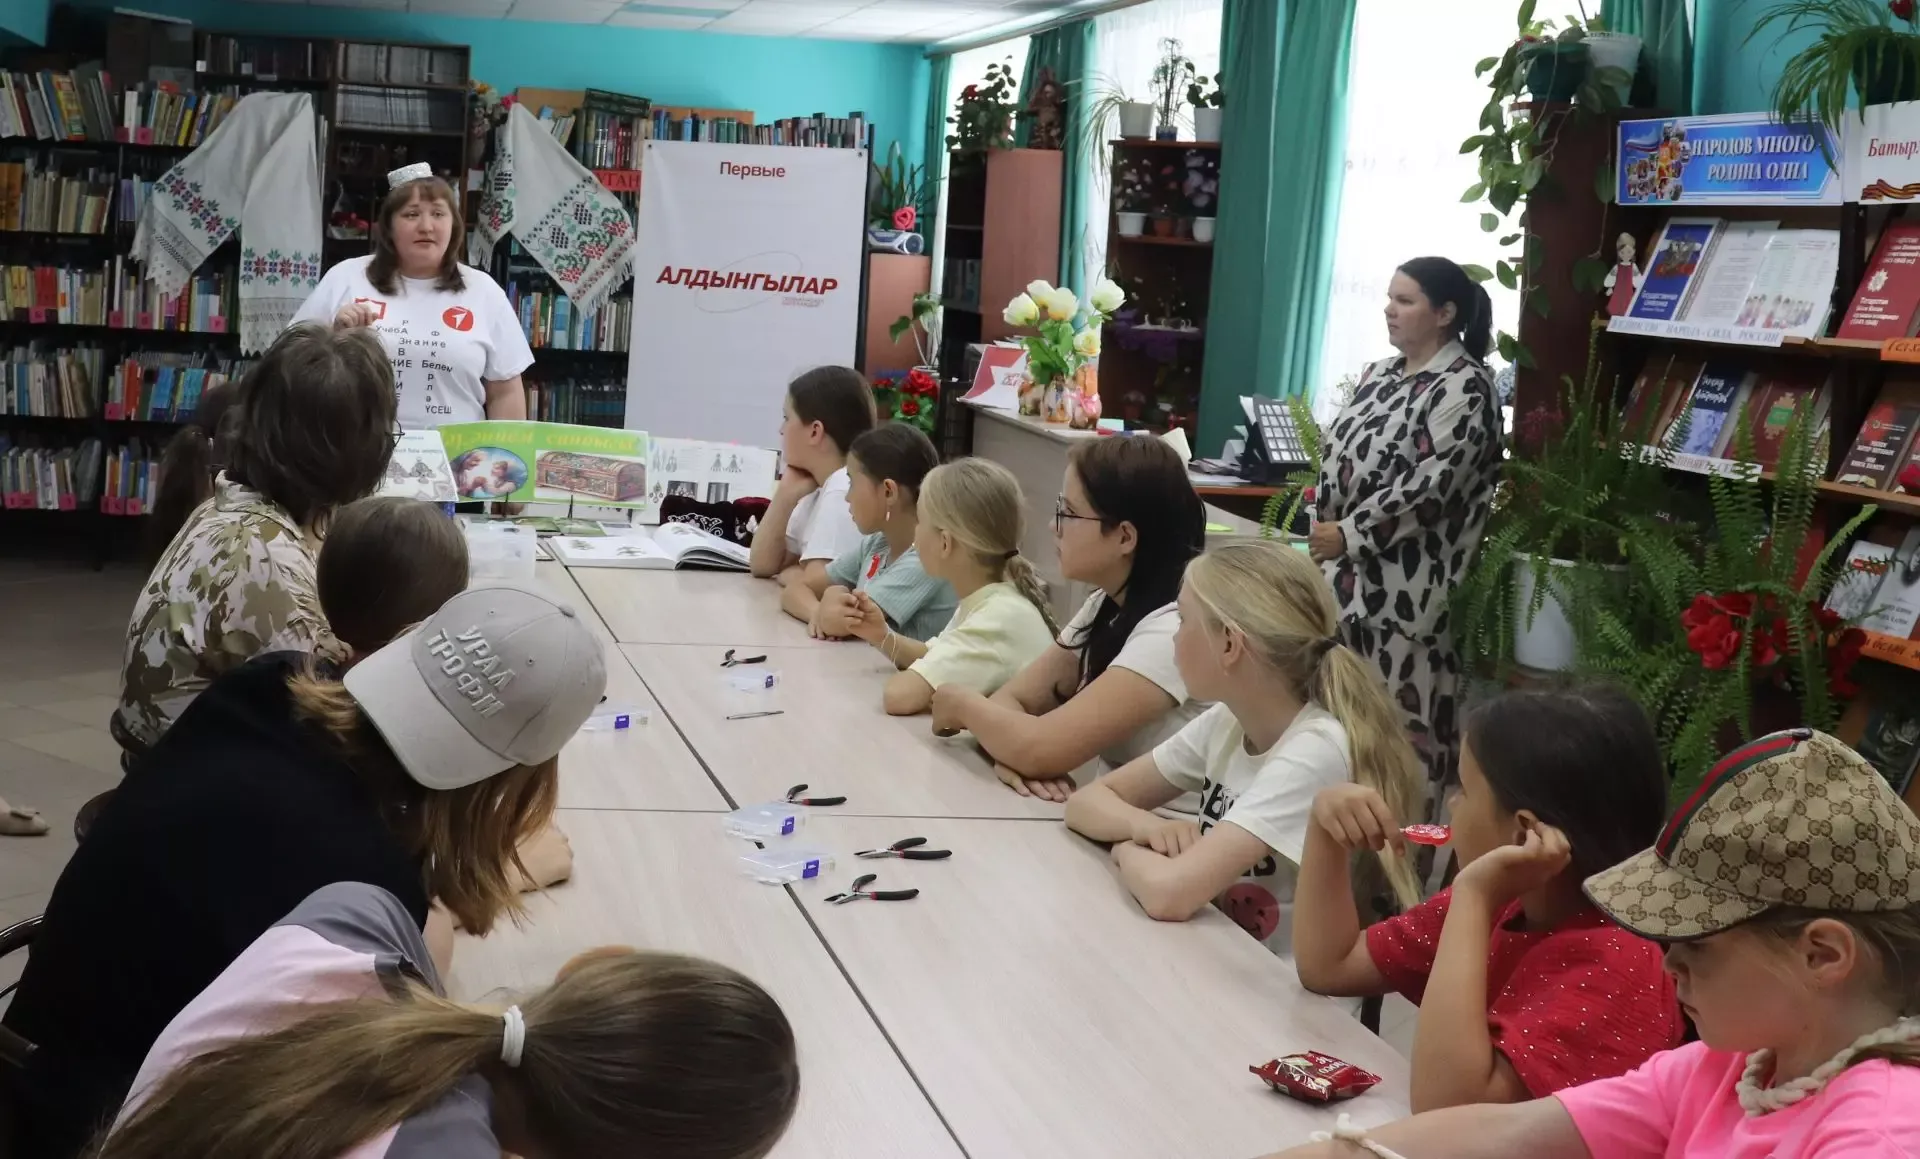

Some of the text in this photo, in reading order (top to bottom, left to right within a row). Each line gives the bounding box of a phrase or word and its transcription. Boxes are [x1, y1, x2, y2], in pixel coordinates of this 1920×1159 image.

[1692, 134, 1815, 157] НАРОДОВ МНОГО
[1868, 138, 1920, 160] Батыр
[719, 161, 786, 180] Первые
[1708, 161, 1809, 181] РОДИНА ОДНА
[656, 265, 838, 295] АЛДЫНГЫЛАР
[399, 337, 447, 349] Знание
[456, 625, 516, 693] УРАЛ
[427, 628, 505, 719] ТРОФИ
